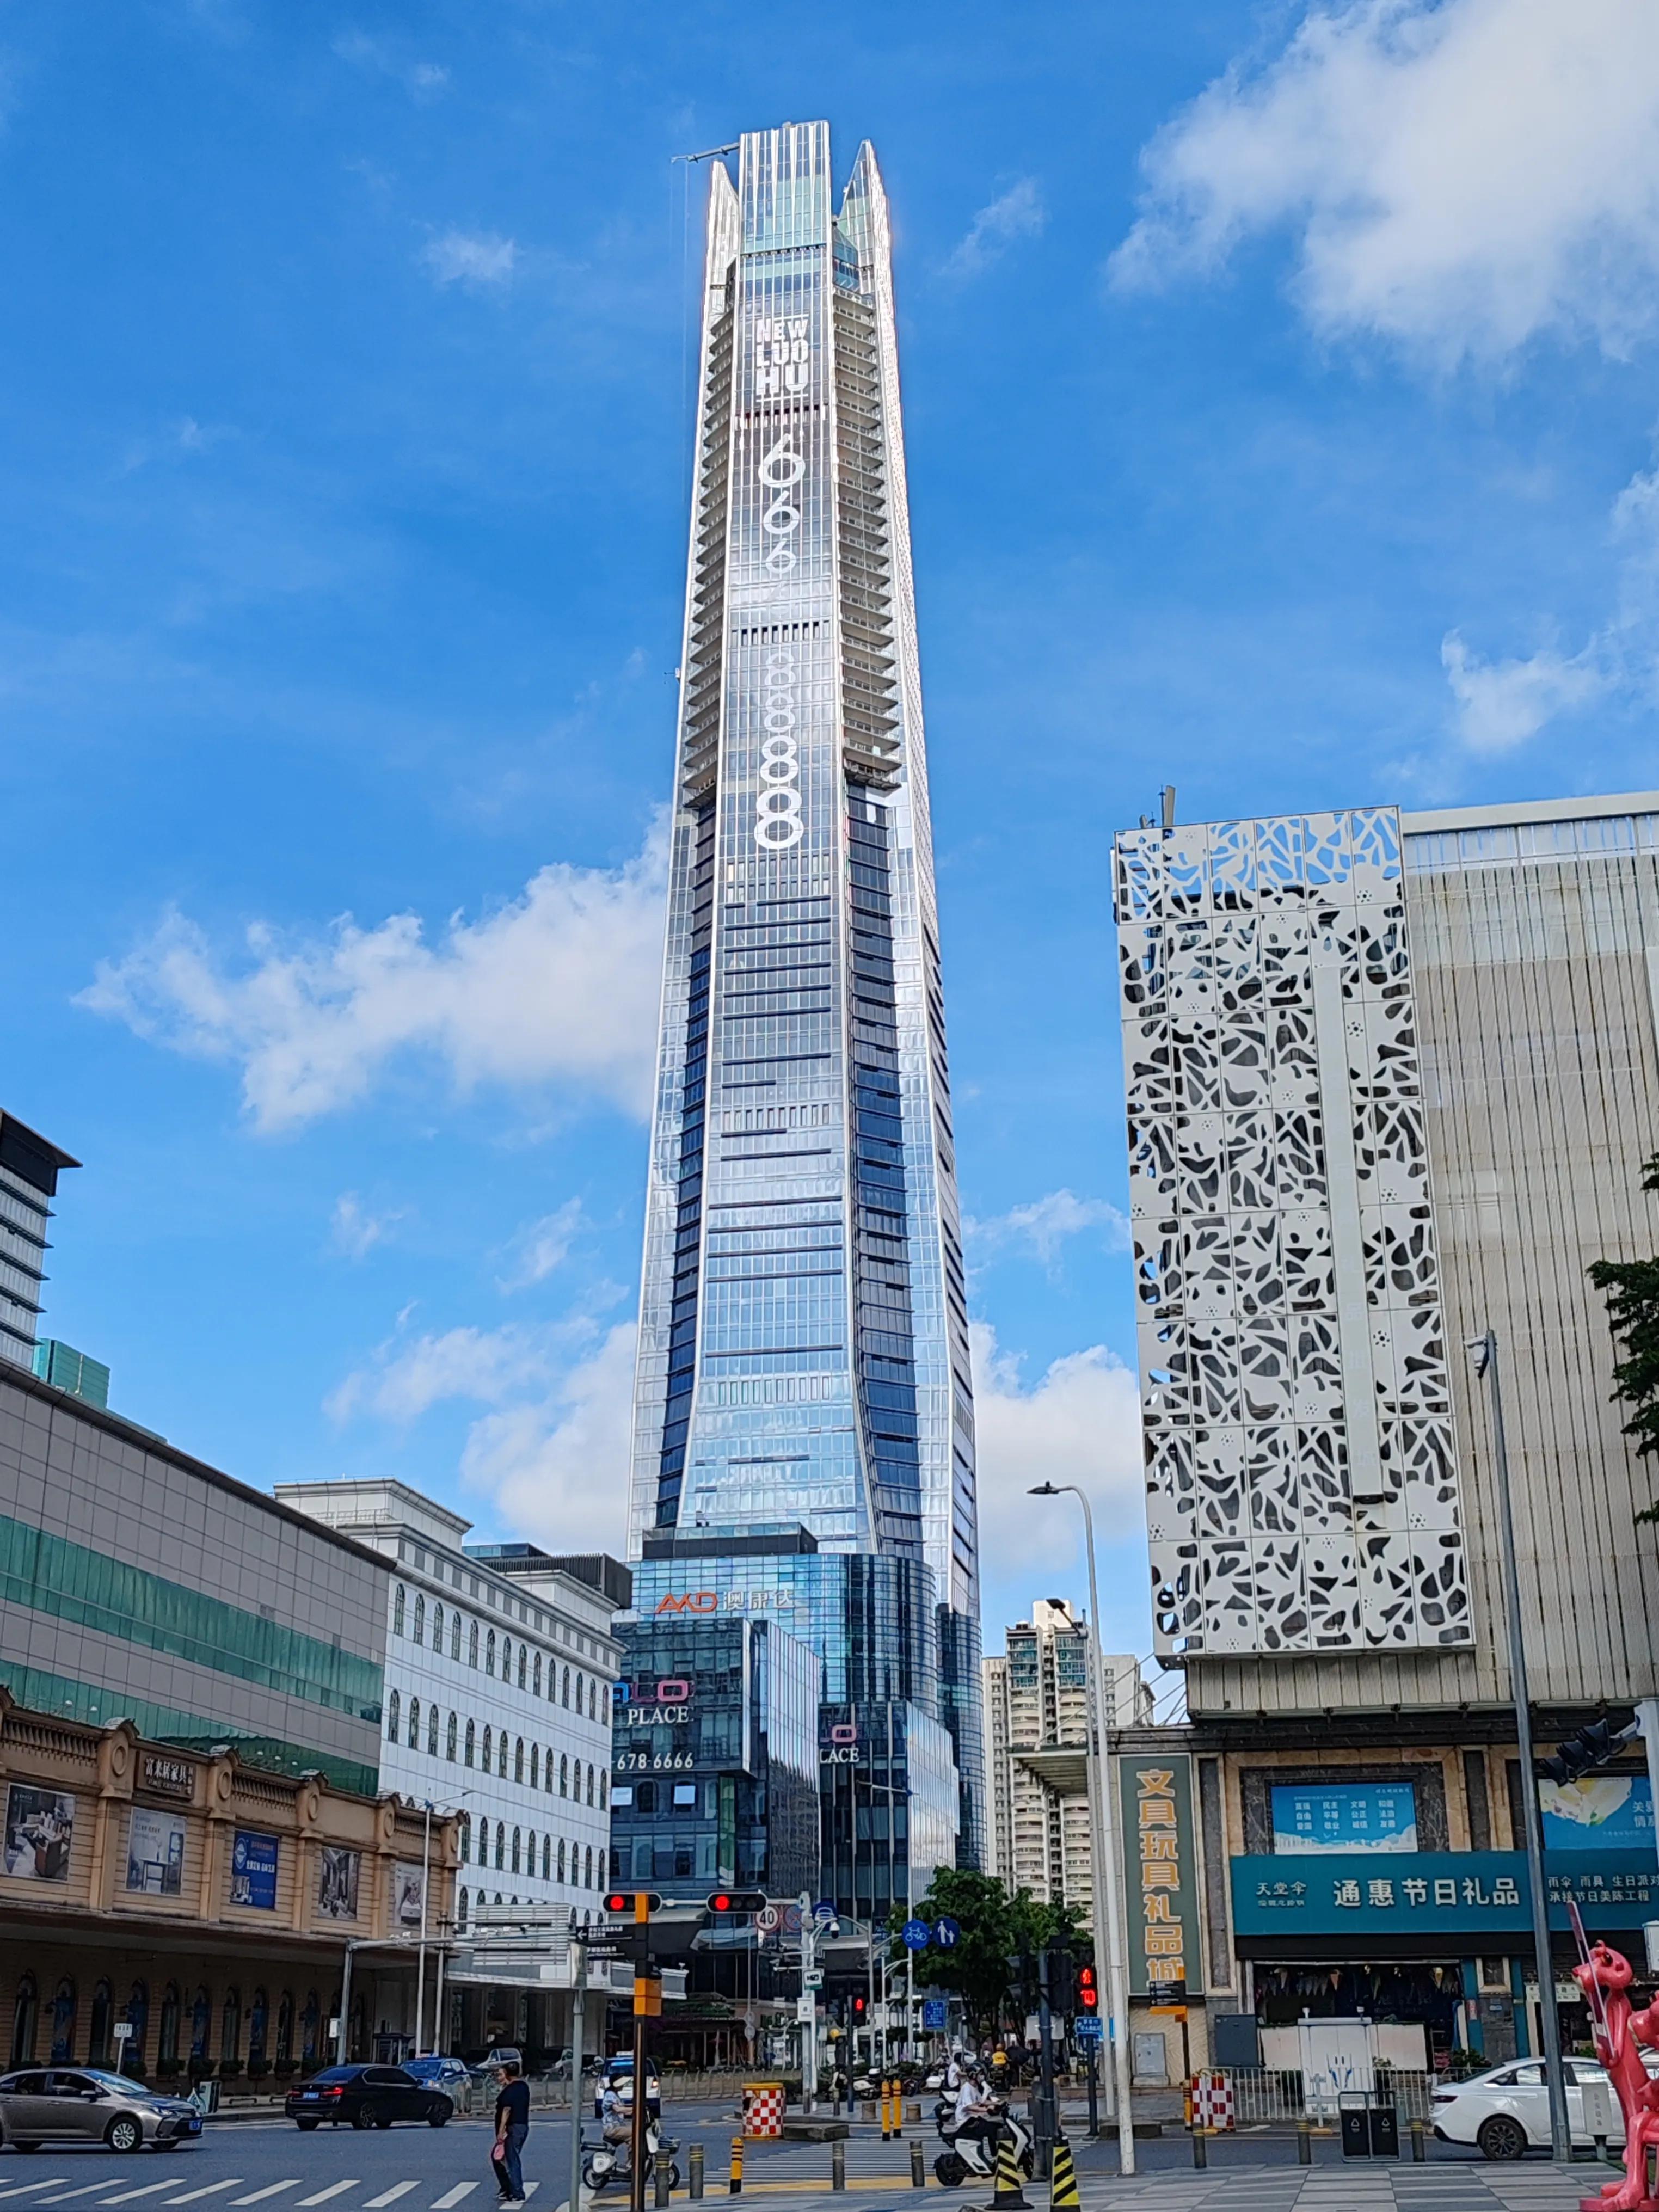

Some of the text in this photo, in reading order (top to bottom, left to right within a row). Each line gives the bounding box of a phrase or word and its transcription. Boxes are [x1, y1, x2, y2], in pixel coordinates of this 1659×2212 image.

[757, 317, 808, 342] NEW
[757, 341, 808, 367] LUO
[757, 364, 808, 395] HU
[723, 1588, 795, 1611] 澳康达
[627, 1706, 689, 1725] PLACE
[1136, 1769, 1185, 1987] 文具玩具礼品城
[1256, 1881, 1306, 1895] 天堂伞
[1547, 1875, 1659, 1888] 雨伞 雨具 生日派对
[1334, 1877, 1520, 1906] 通惠节日礼品
[1550, 1890, 1650, 1903] 承接节日美陈工程
[760, 1910, 775, 1925] 40
